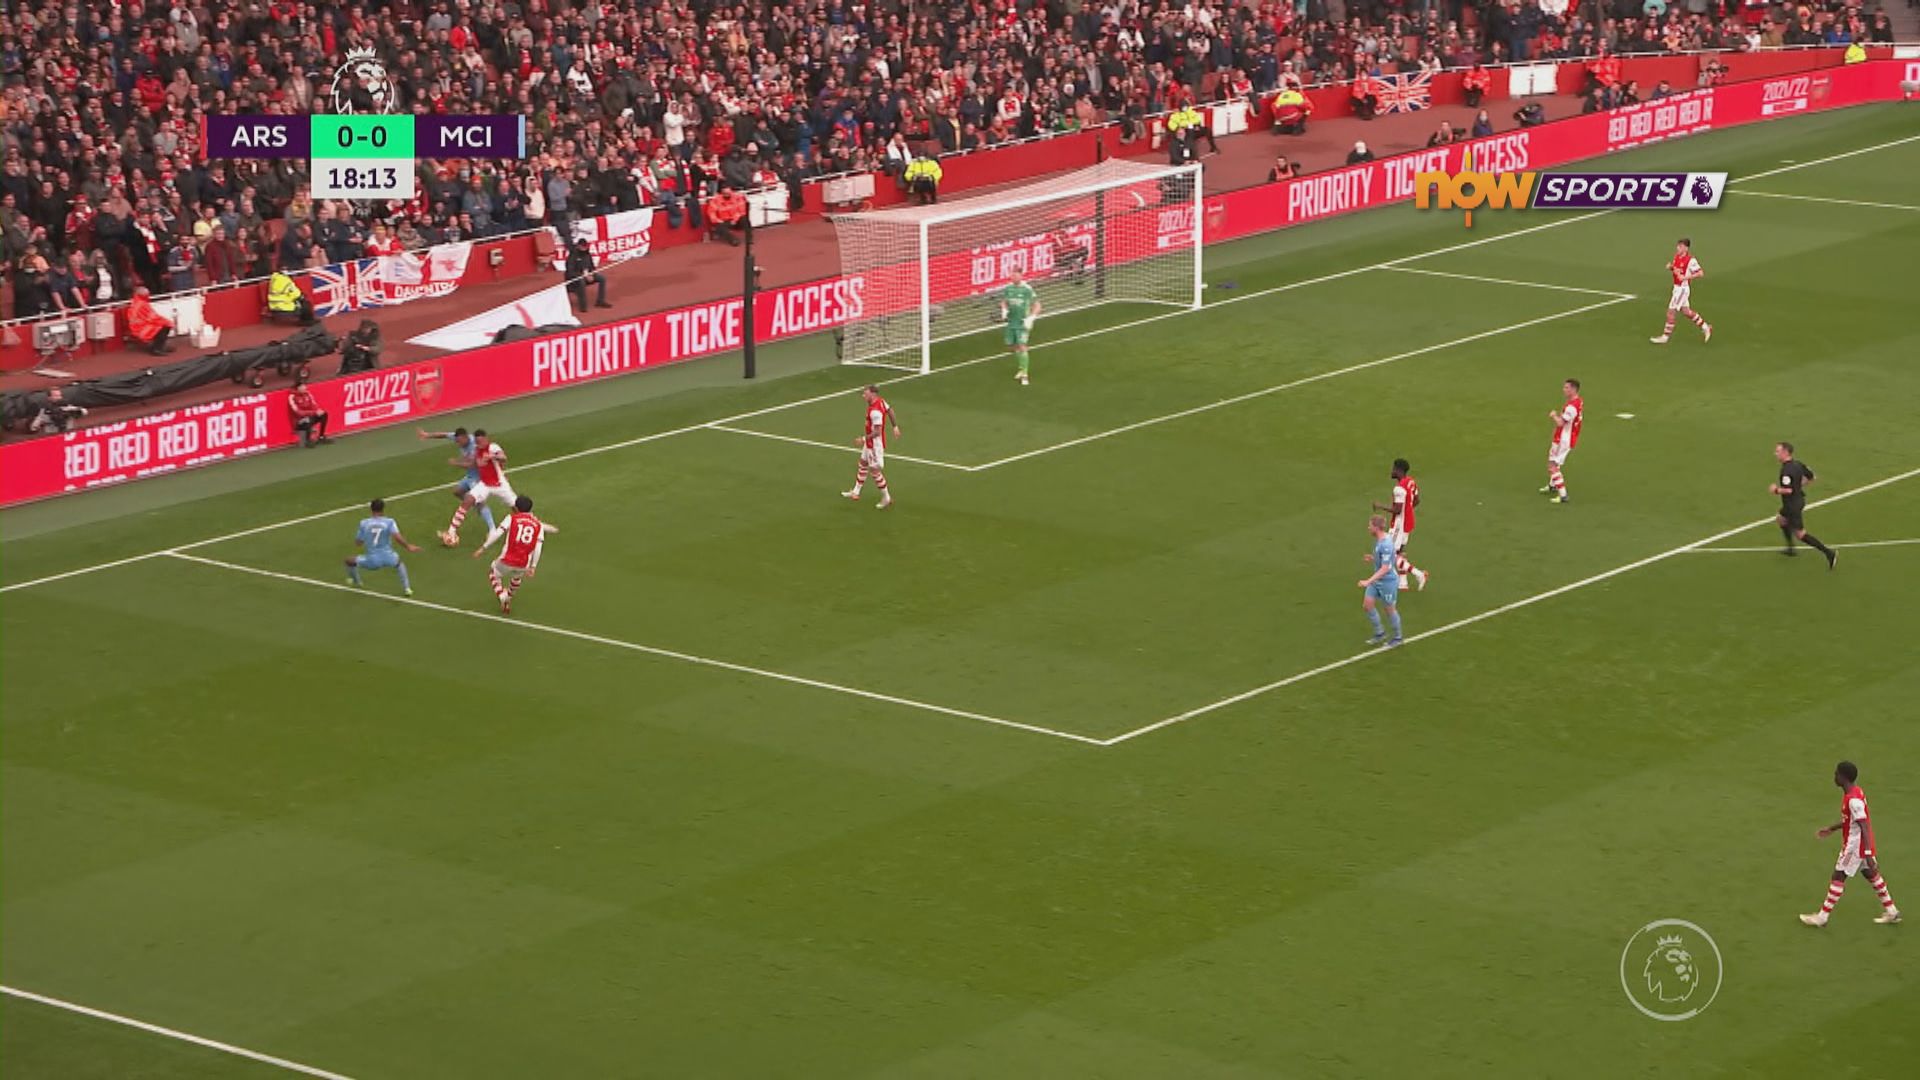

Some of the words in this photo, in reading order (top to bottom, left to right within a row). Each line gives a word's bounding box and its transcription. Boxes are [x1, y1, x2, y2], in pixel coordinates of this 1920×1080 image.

[1762, 77, 1809, 101] 2021/22
[1630, 111, 1652, 138] RED
[1654, 105, 1677, 132] RED
[1679, 99, 1701, 126] RED
[1288, 166, 1374, 221] PRIORITY
[1033, 242, 1055, 272] RE
[532, 319, 651, 387] PRIORITY
[770, 276, 865, 336] ACCESS
[344, 370, 410, 407] 2021/22
[108, 431, 150, 470] RED
[158, 420, 199, 459] RED
[207, 410, 247, 449] RED
[371, 527, 382, 546] 7
[516, 523, 535, 545] 18
